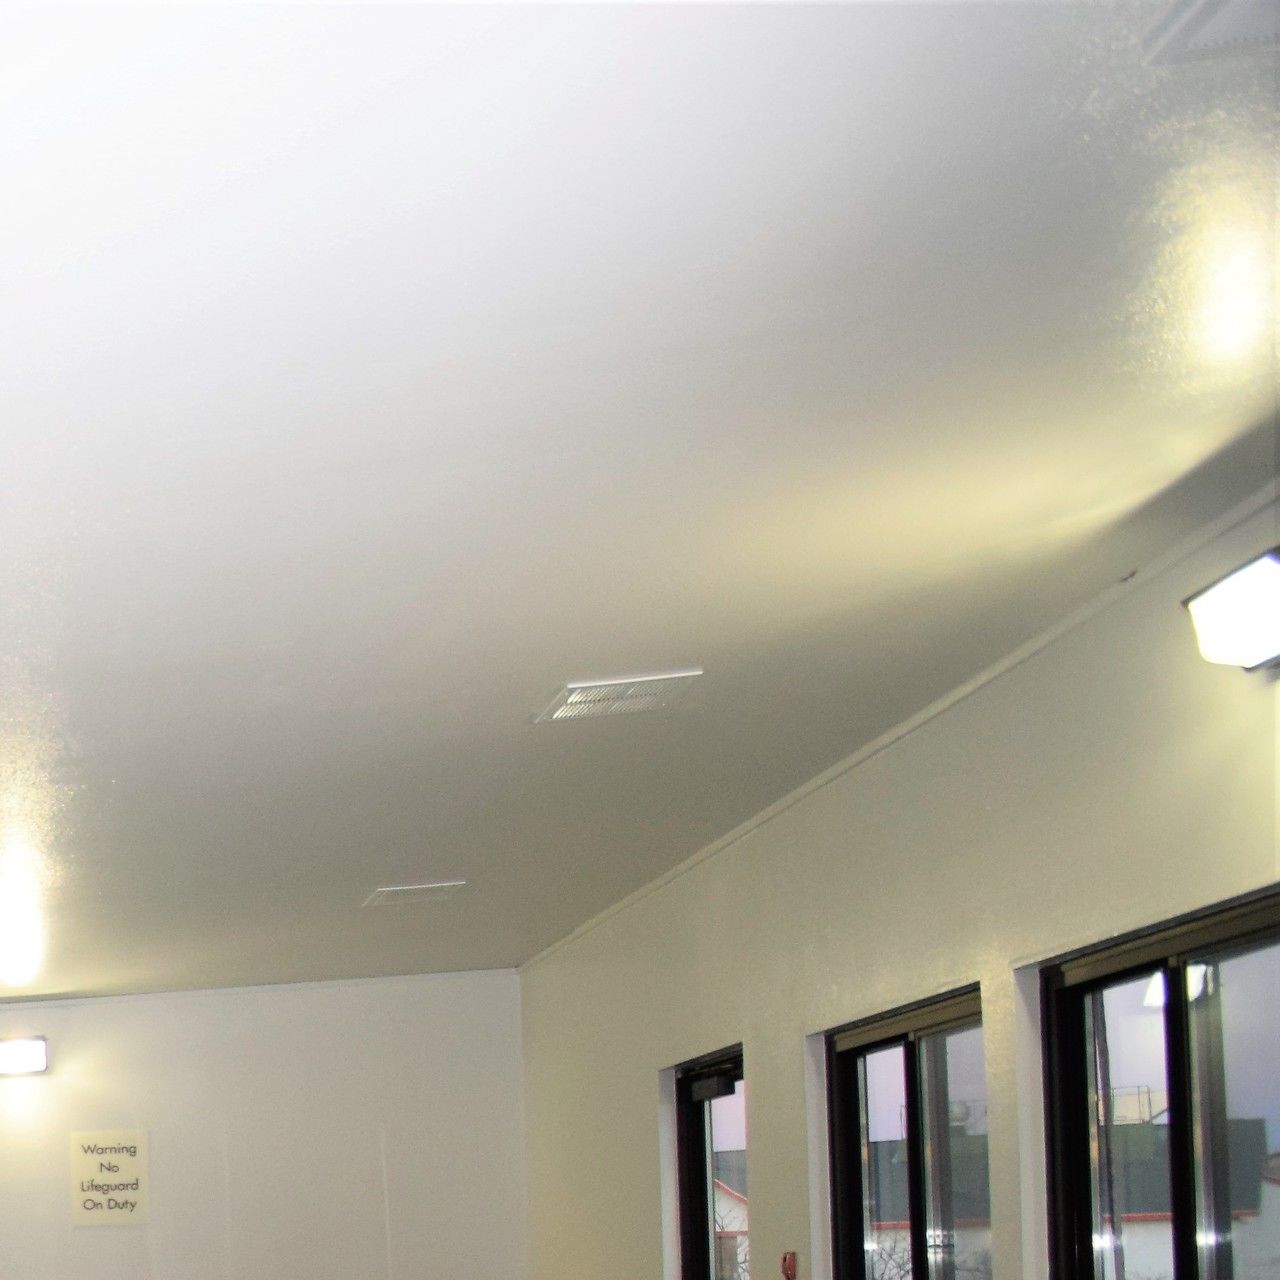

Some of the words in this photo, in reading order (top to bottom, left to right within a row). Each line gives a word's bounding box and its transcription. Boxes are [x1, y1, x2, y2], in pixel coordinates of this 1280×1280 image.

[81, 1143, 137, 1157] Warning
[100, 1162, 120, 1173] No
[81, 1178, 139, 1194] Lifeguard
[83, 1198, 103, 1210] On
[107, 1198, 137, 1212] Duty
